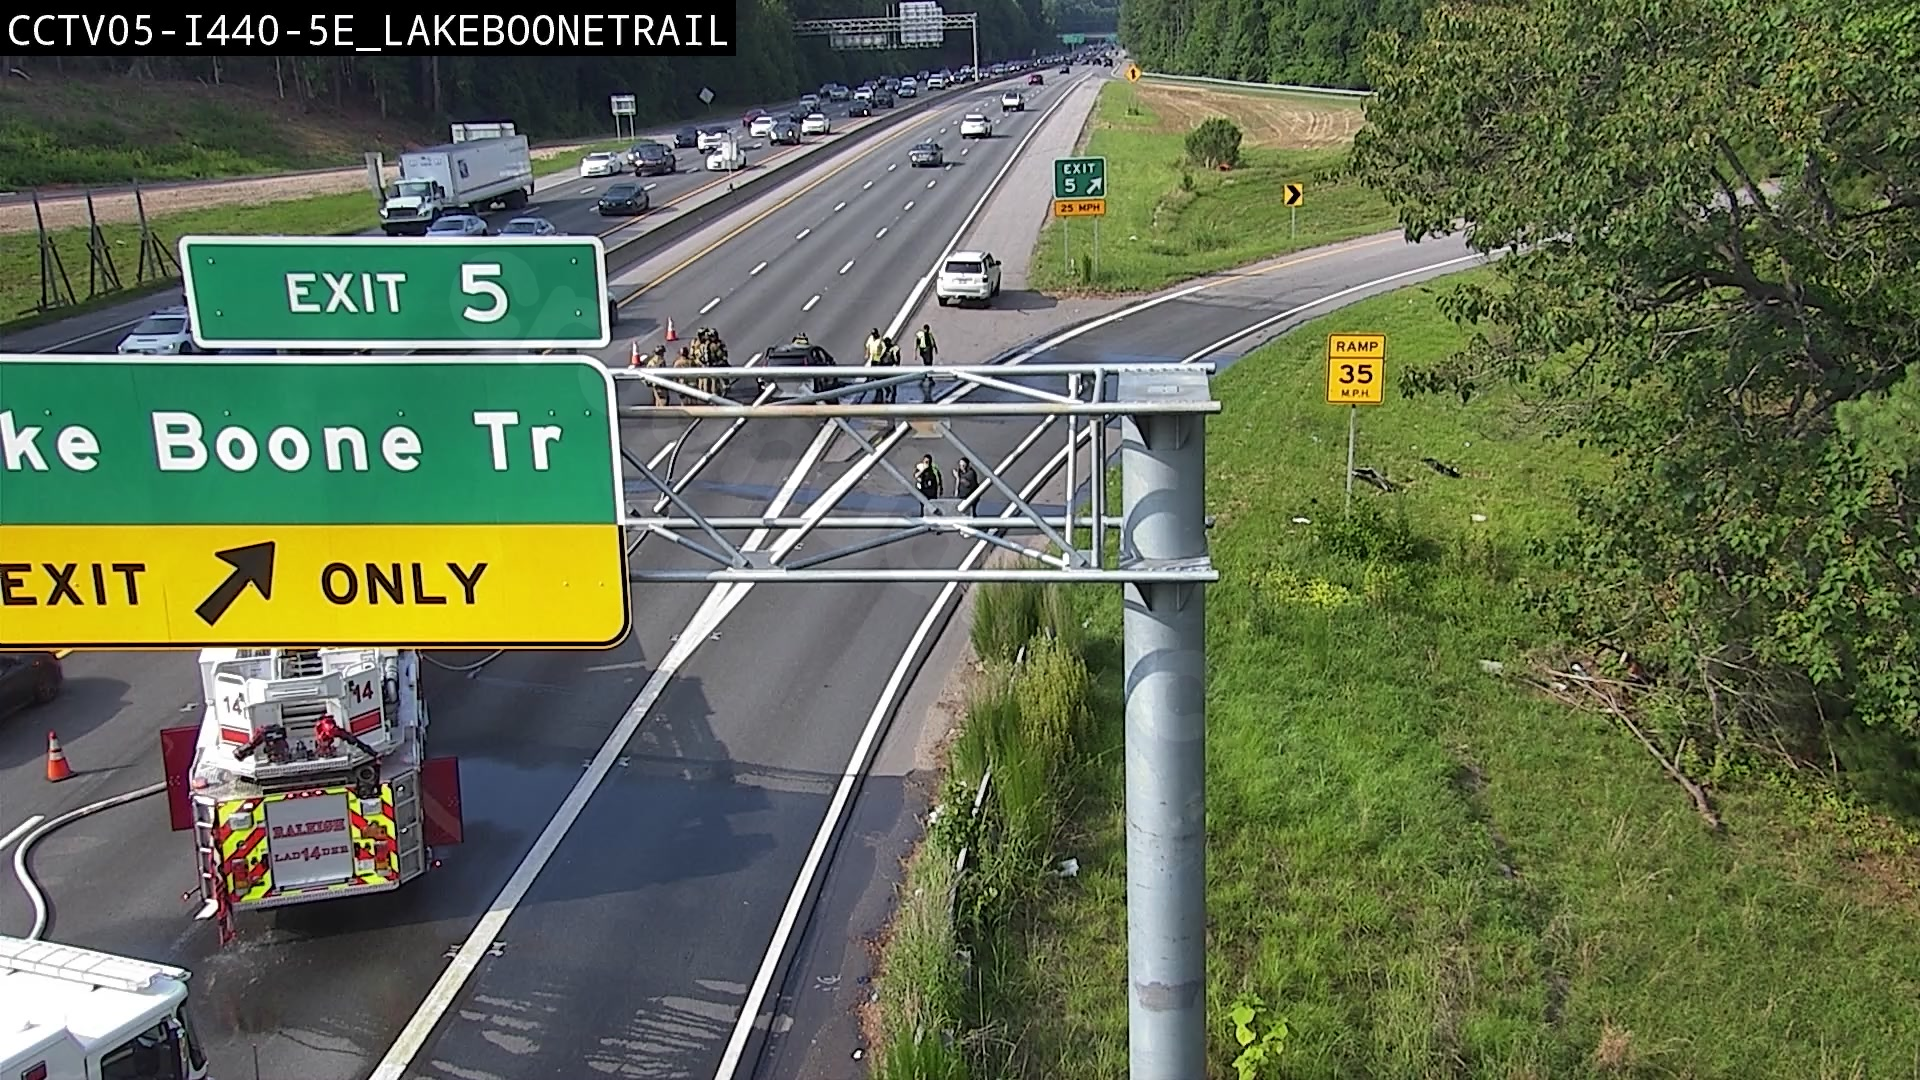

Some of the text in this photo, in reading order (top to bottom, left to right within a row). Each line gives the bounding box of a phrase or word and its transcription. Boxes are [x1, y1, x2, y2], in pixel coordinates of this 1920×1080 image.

[1063, 163, 1096, 174] EXIT
[1065, 178, 1076, 193] 5
[1061, 203, 1100, 212] 25 MPH
[285, 263, 508, 323] EXIT 5
[1336, 341, 1379, 352] RAMP
[1339, 364, 1373, 384] 35
[151, 411, 422, 472] Boone
[474, 411, 562, 470] Tr
[0, 563, 488, 605] EXIT ONLY
[353, 680, 374, 704] 14
[223, 695, 243, 716] 14
[272, 818, 346, 840] RALEIGH
